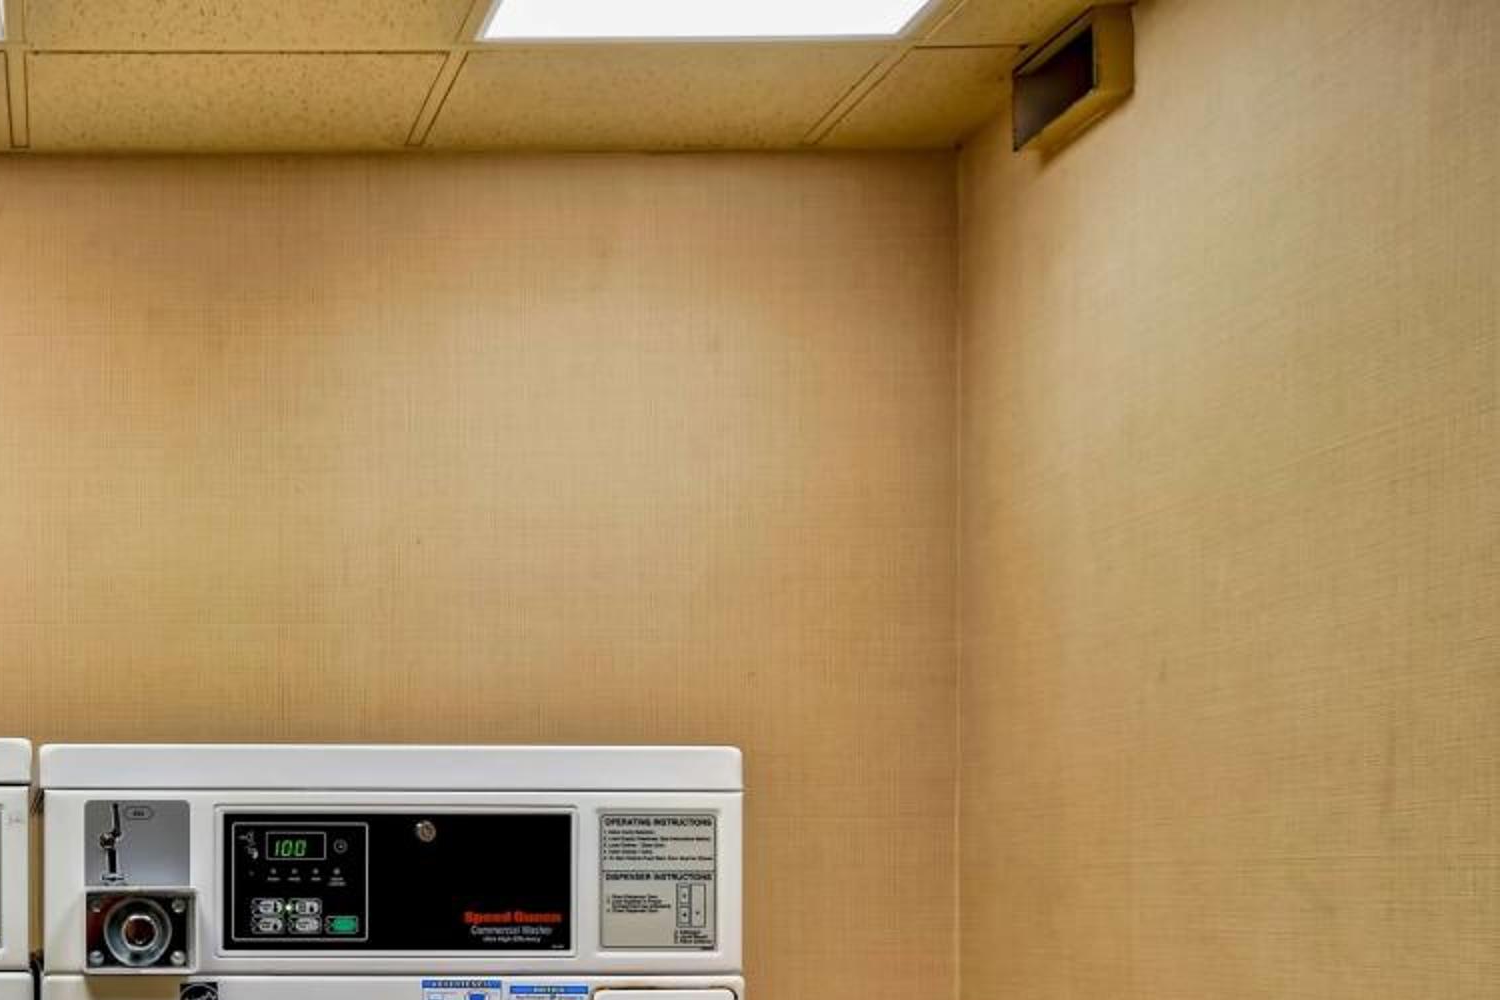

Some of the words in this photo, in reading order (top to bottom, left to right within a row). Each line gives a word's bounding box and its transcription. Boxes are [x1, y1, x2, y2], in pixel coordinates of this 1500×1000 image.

[605, 818, 651, 826] OPERATING
[653, 818, 712, 826] INSTRUCTIONS
[274, 839, 307, 857] 100
[605, 873, 651, 881] DISPENSER
[653, 873, 713, 881] INSTRUCTIONS
[464, 911, 511, 925] Speed
[514, 911, 562, 923] Queen
[471, 925, 520, 935] Commercial
